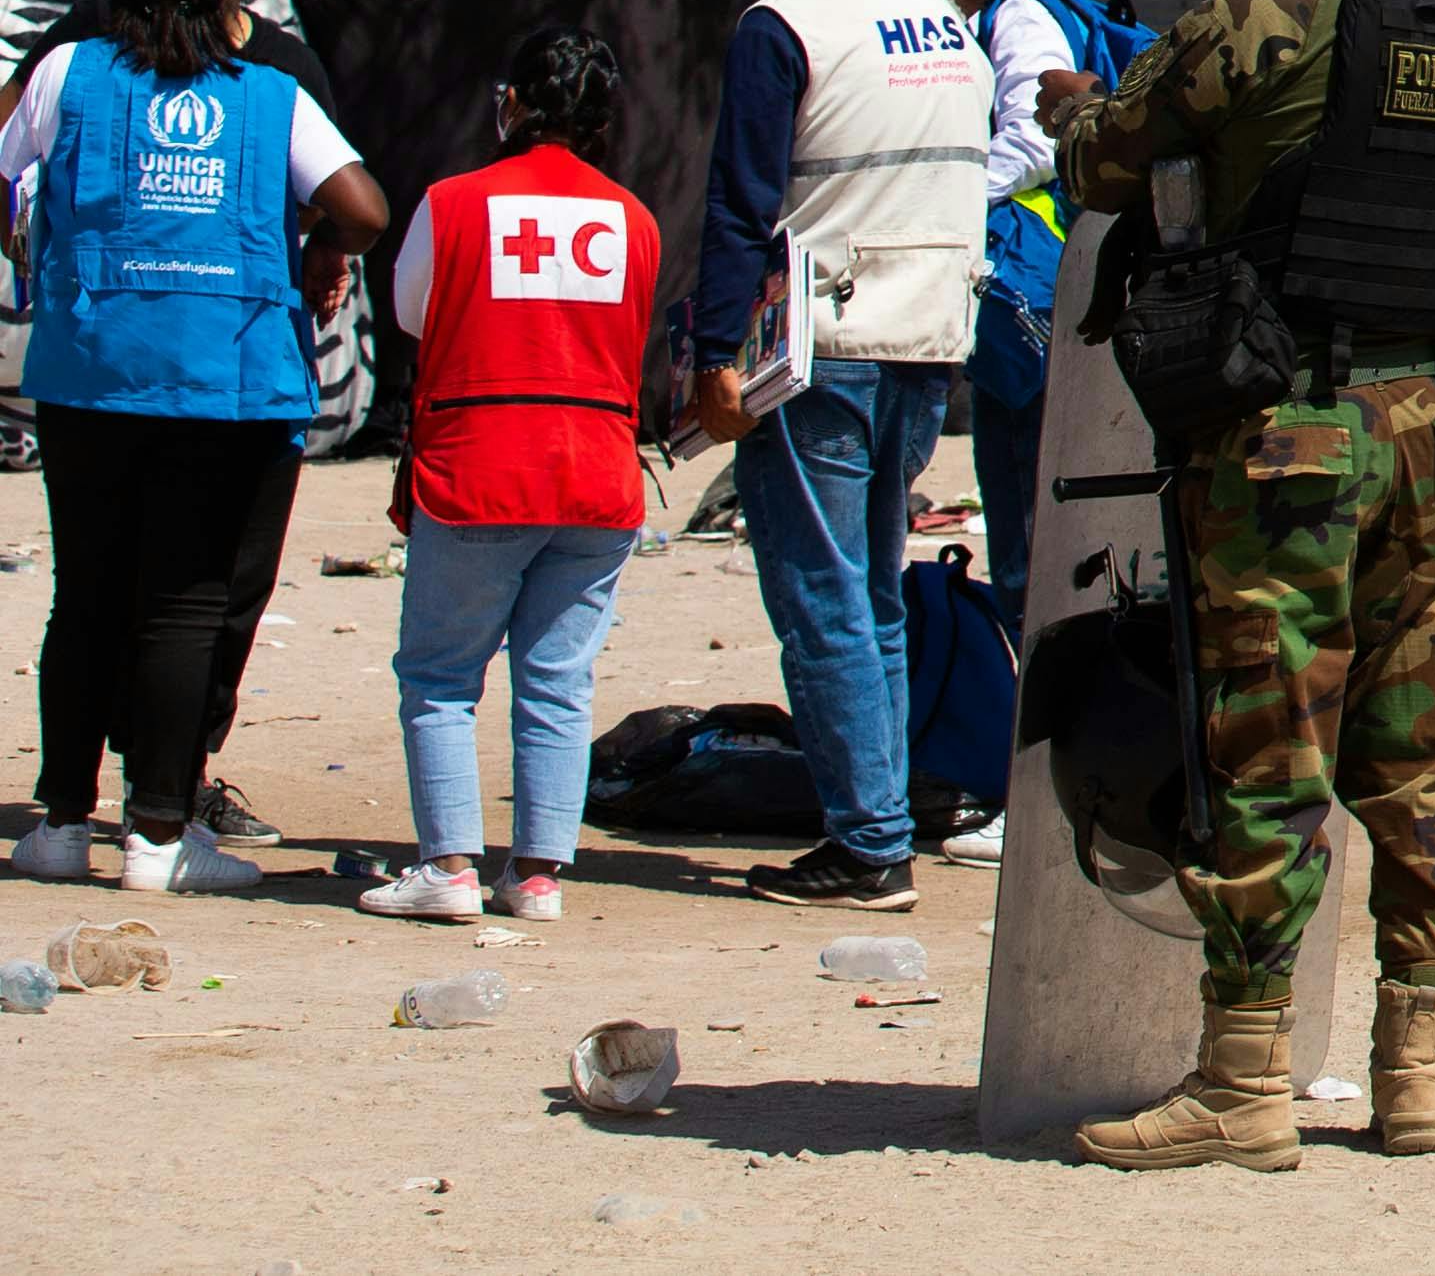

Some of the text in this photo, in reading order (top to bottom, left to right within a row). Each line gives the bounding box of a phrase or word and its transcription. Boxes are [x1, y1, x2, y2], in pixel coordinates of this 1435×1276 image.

[876, 16, 965, 54] HIAS
[138, 152, 226, 177] UNHCR
[138, 172, 225, 198] ACNUR
[123, 260, 235, 275] #ConLosRefugiados
